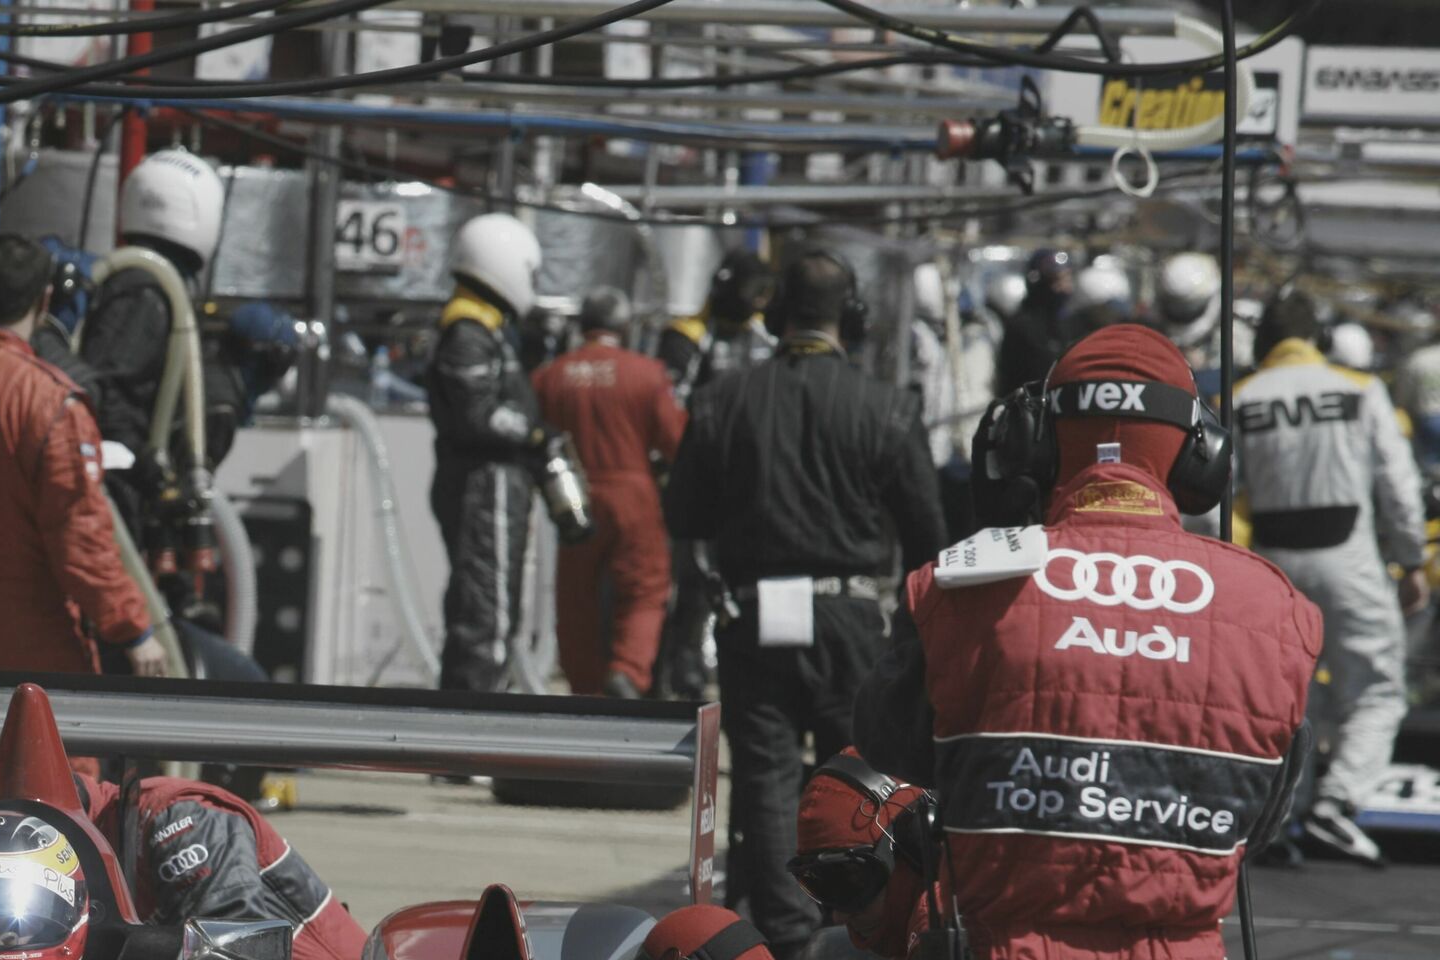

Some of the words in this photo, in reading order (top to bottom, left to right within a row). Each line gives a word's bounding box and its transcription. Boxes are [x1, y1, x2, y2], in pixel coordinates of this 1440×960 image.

[335, 211, 399, 257] 46
[1054, 616, 1190, 663] Audi
[1010, 747, 1110, 784] Audi
[986, 782, 1065, 819] Top
[1079, 787, 1235, 835] Service
[44, 867, 75, 903] Plus
